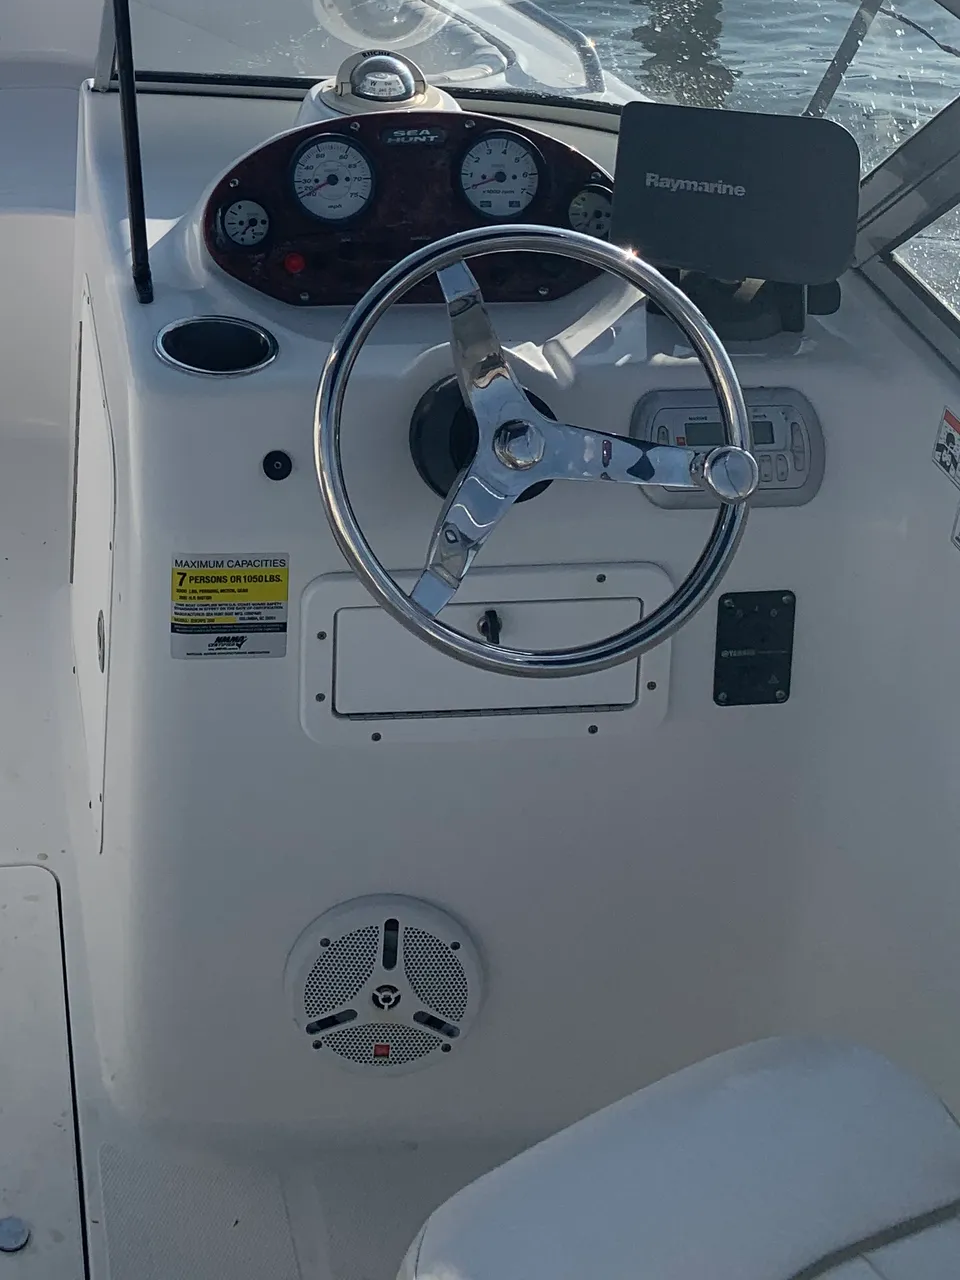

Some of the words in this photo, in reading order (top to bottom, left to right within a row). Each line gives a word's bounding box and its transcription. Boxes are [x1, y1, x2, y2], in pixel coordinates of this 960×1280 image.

[362, 50, 392, 58] RITCHIE
[393, 129, 431, 137] SEA
[387, 135, 439, 144] HUNT
[645, 172, 746, 197] Raymarine
[174, 559, 225, 569] MAXIMUM
[226, 559, 287, 568] CAPACITIES
[177, 571, 187, 587] 7
[189, 575, 228, 584] PERSONS
[230, 575, 242, 583] OR
[243, 574, 264, 583] 1050
[264, 574, 283, 583] LBS.
